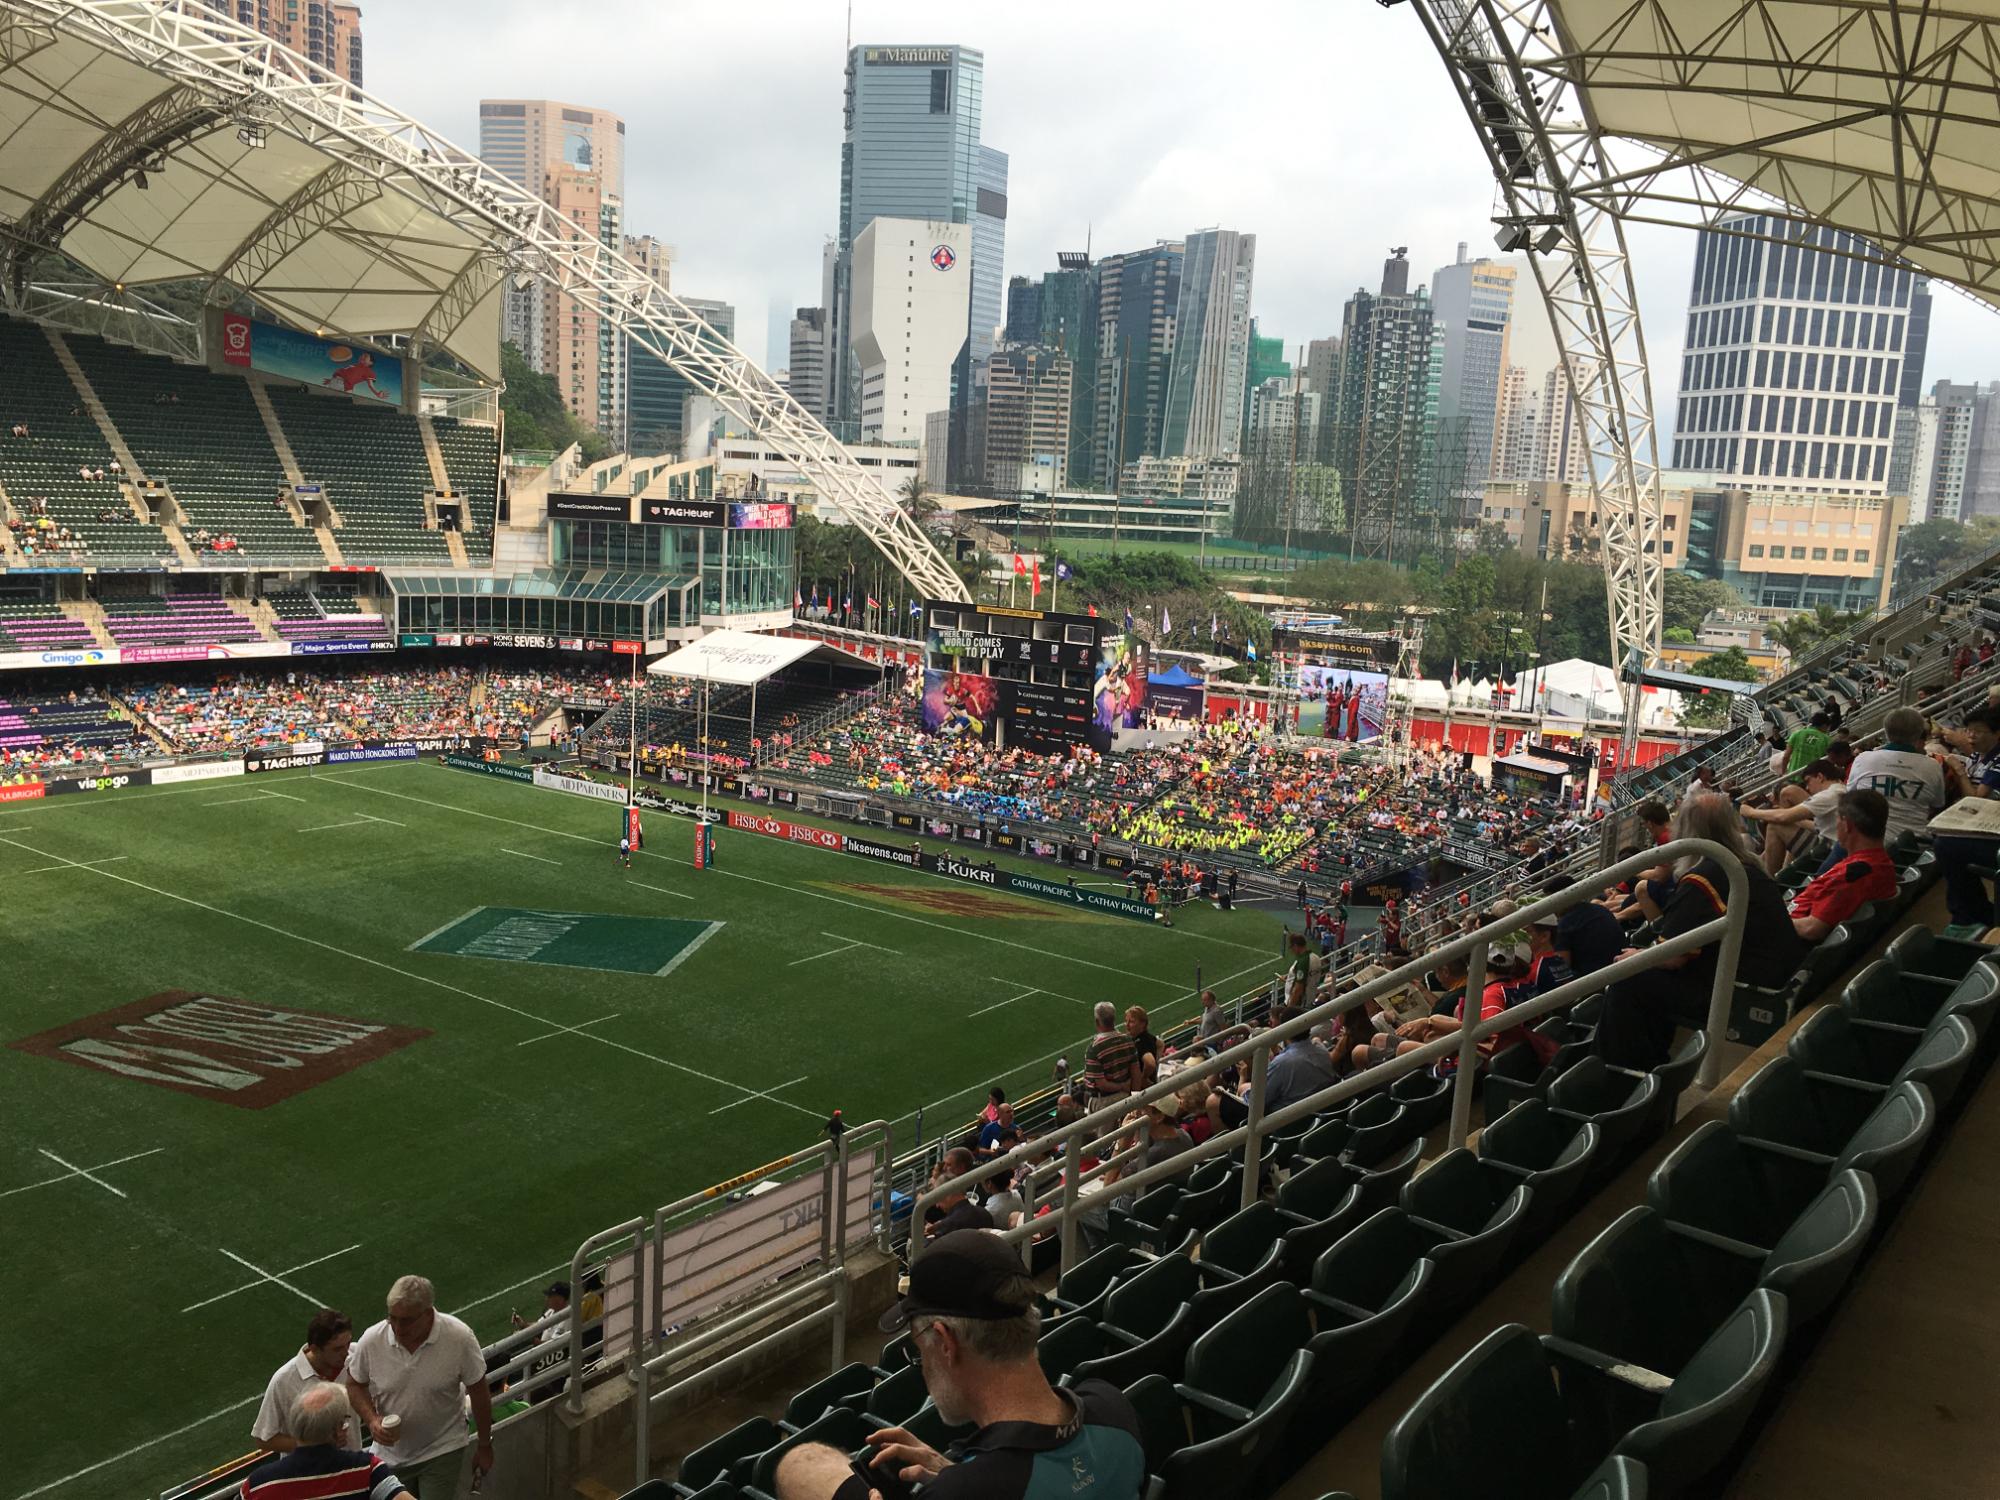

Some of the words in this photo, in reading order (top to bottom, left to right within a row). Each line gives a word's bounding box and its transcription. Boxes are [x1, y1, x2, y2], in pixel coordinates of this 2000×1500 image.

[886, 47, 949, 62] Manulife
[662, 507, 683, 517] TAG
[683, 508, 714, 518] Heuer
[514, 635, 545, 648] SEVENS
[939, 630, 960, 639] WHERE
[305, 644, 325, 653] Major
[326, 643, 347, 652] Sports
[347, 642, 368, 650] Event
[944, 637, 971, 647] WORLD
[973, 638, 1002, 648] COMES
[1299, 638, 1372, 655] hksevens.com
[42, 652, 83, 665] Cimigo
[965, 647, 978, 658] TO
[980, 647, 1005, 659] PLAY
[329, 752, 350, 762] MARCO
[350, 751, 364, 760] POLO
[365, 749, 398, 760] HONGKONG
[398, 747, 417, 757] HOTEL
[262, 759, 288, 771] TAG
[288, 755, 323, 769] Heuer
[448, 757, 467, 767] CATHAY
[467, 761, 486, 771] PACIFIC
[495, 766, 514, 776] CATHAY
[514, 770, 533, 780] PACIFIC
[78, 775, 129, 791] viagogo
[560, 779, 575, 791] AID
[576, 782, 625, 801] PARTNERS
[1872, 775, 1925, 800] HK7
[0, 788, 43, 801] ULBRIGHT
[735, 813, 764, 832] HSBC
[789, 824, 820, 843] HSBC
[848, 839, 912, 865] hksevens.com
[948, 860, 995, 884] KUKRI
[1011, 878, 1042, 892] CATHAY
[1042, 885, 1072, 899] PACIFIC
[1088, 894, 1120, 910] CATHAY
[1121, 900, 1153, 917] PACIFIC
[1756, 1010, 1768, 1021] 14
